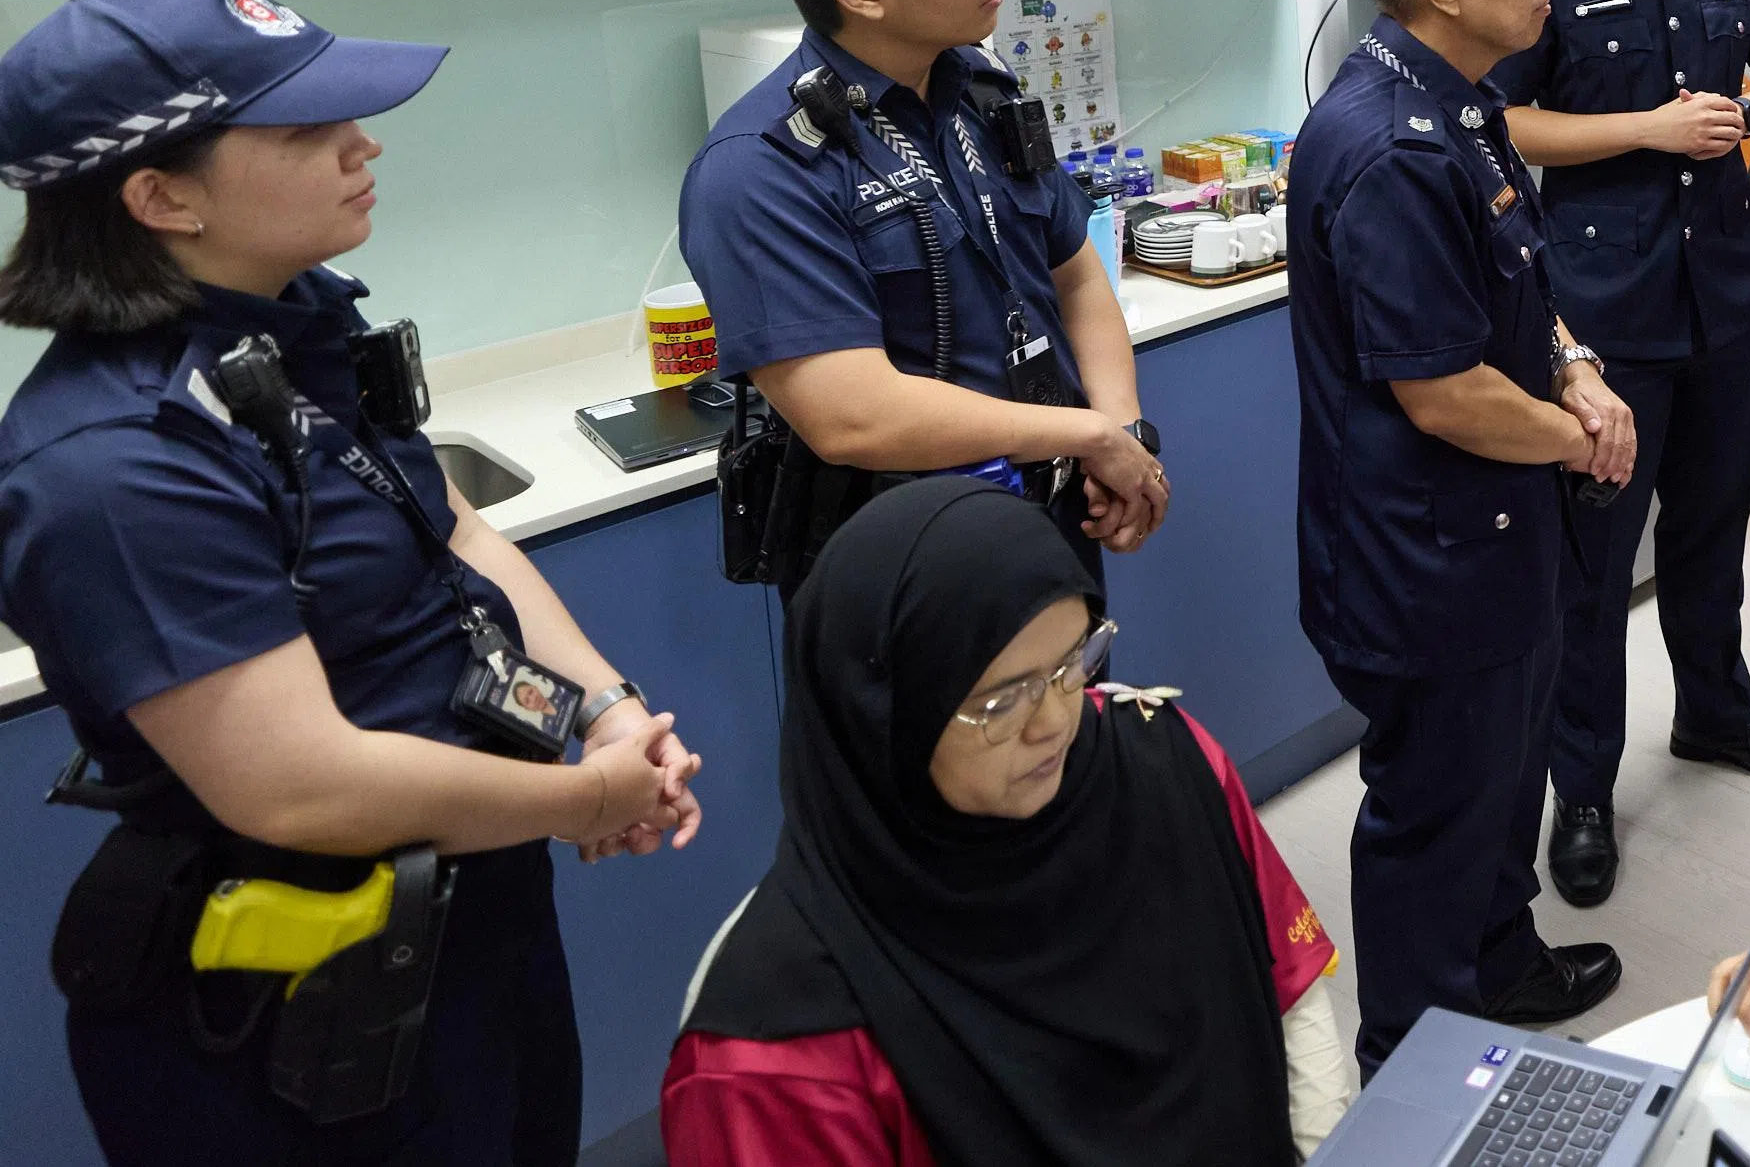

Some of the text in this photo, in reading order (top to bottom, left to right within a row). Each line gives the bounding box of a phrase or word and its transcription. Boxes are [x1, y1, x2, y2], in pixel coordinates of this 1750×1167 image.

[652, 337, 716, 360] SUPER
[666, 334, 680, 343] for
[654, 355, 718, 375] PERSON
